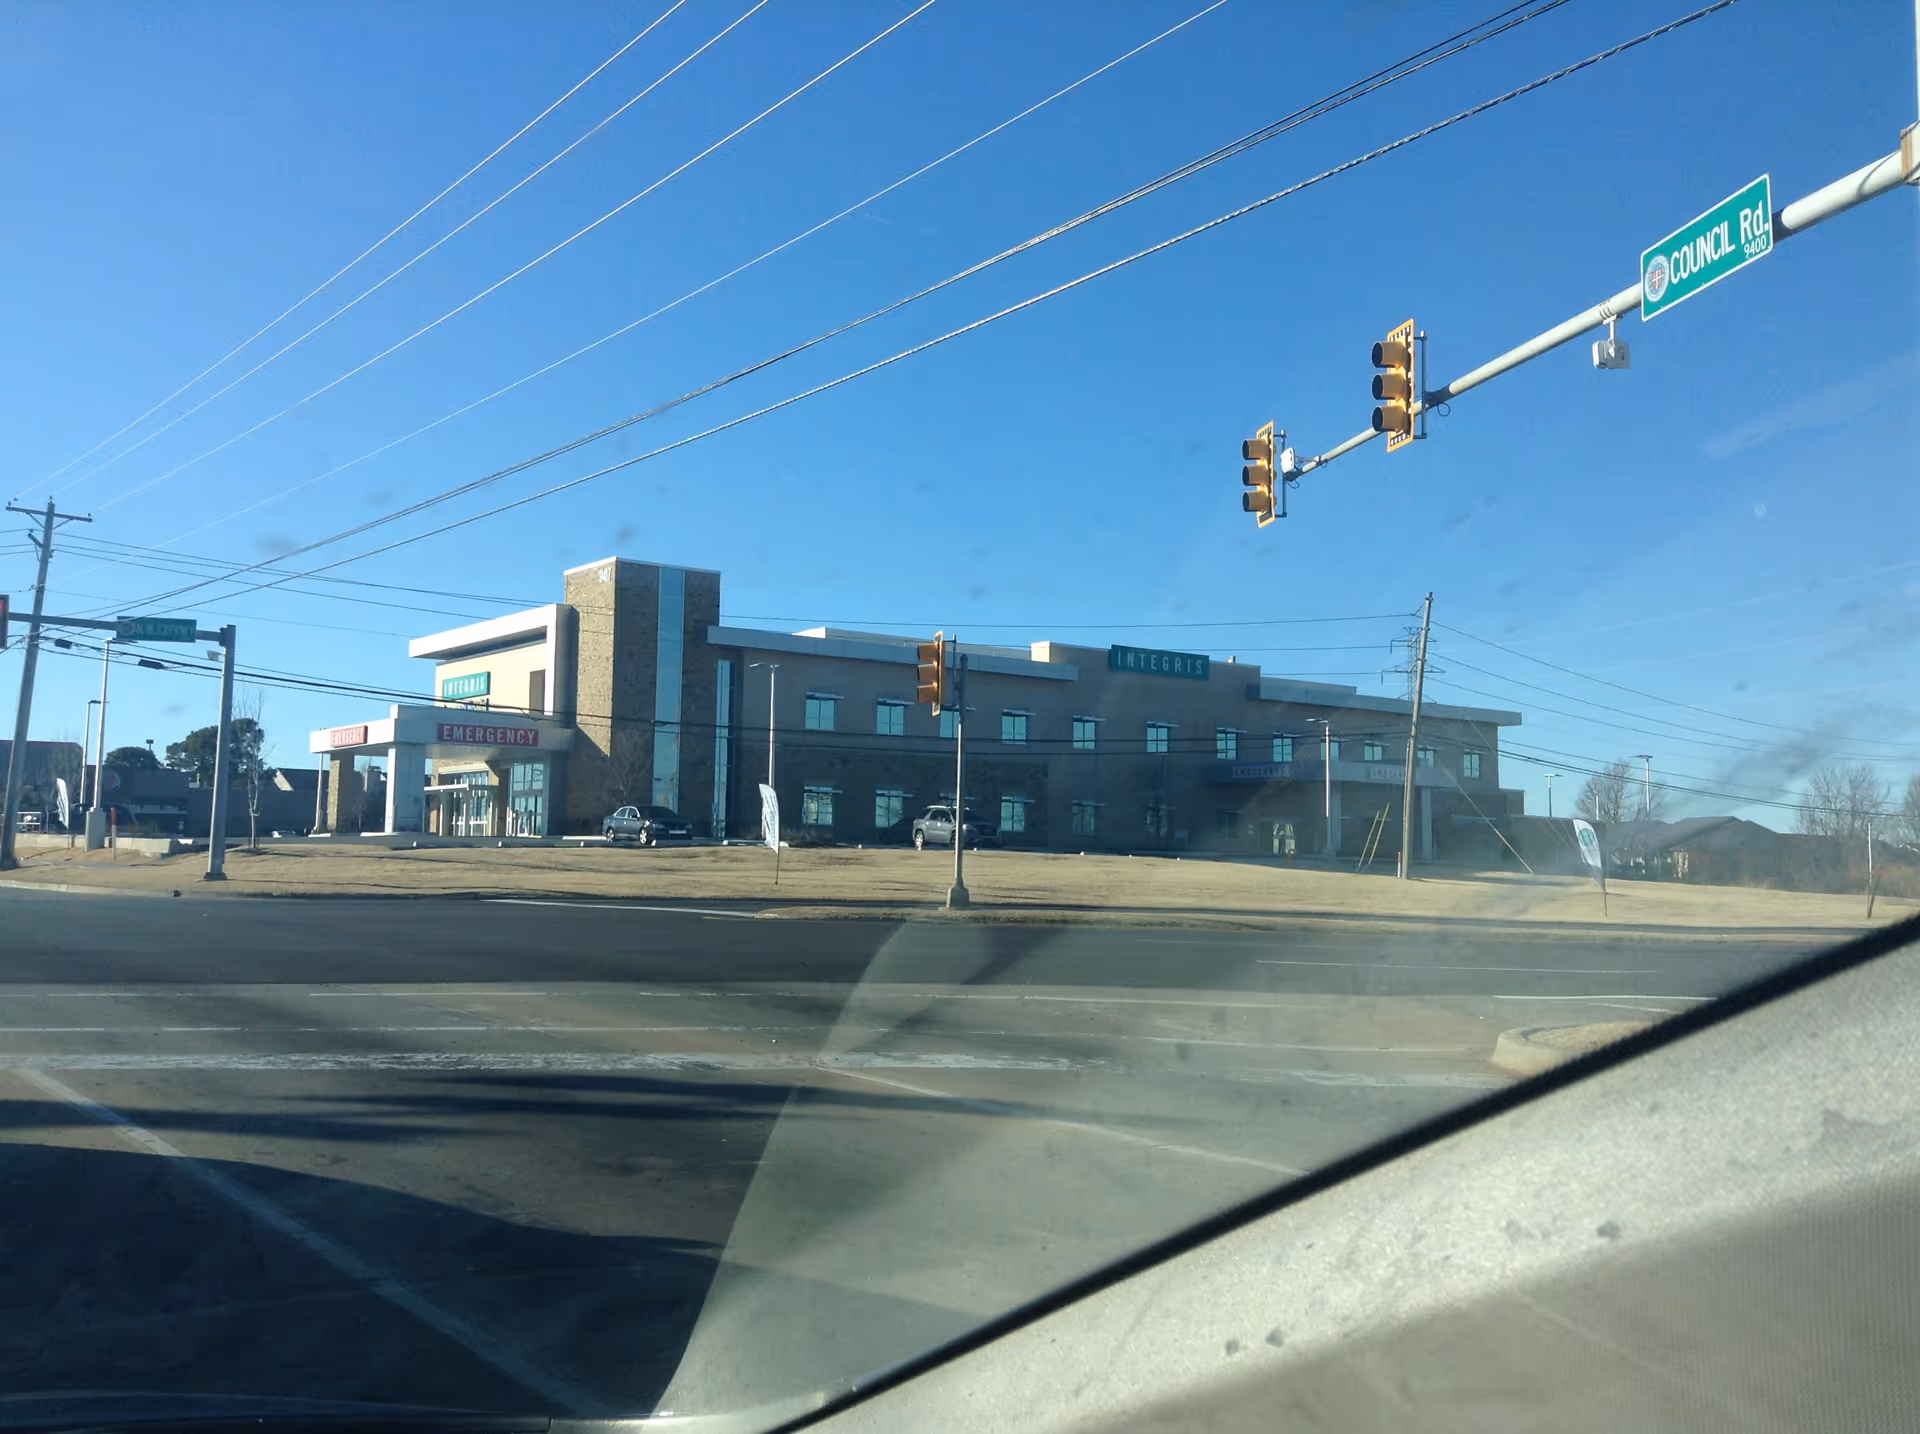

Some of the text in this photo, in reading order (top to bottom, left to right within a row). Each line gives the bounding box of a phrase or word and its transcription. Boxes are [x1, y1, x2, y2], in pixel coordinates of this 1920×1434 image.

[1670, 220, 1736, 285] COUNCIL
[1739, 200, 1769, 245] Rd.
[1744, 234, 1767, 259] 9400
[1117, 649, 1203, 675] INTEGRIS
[443, 725, 536, 745] EMERGENCY
